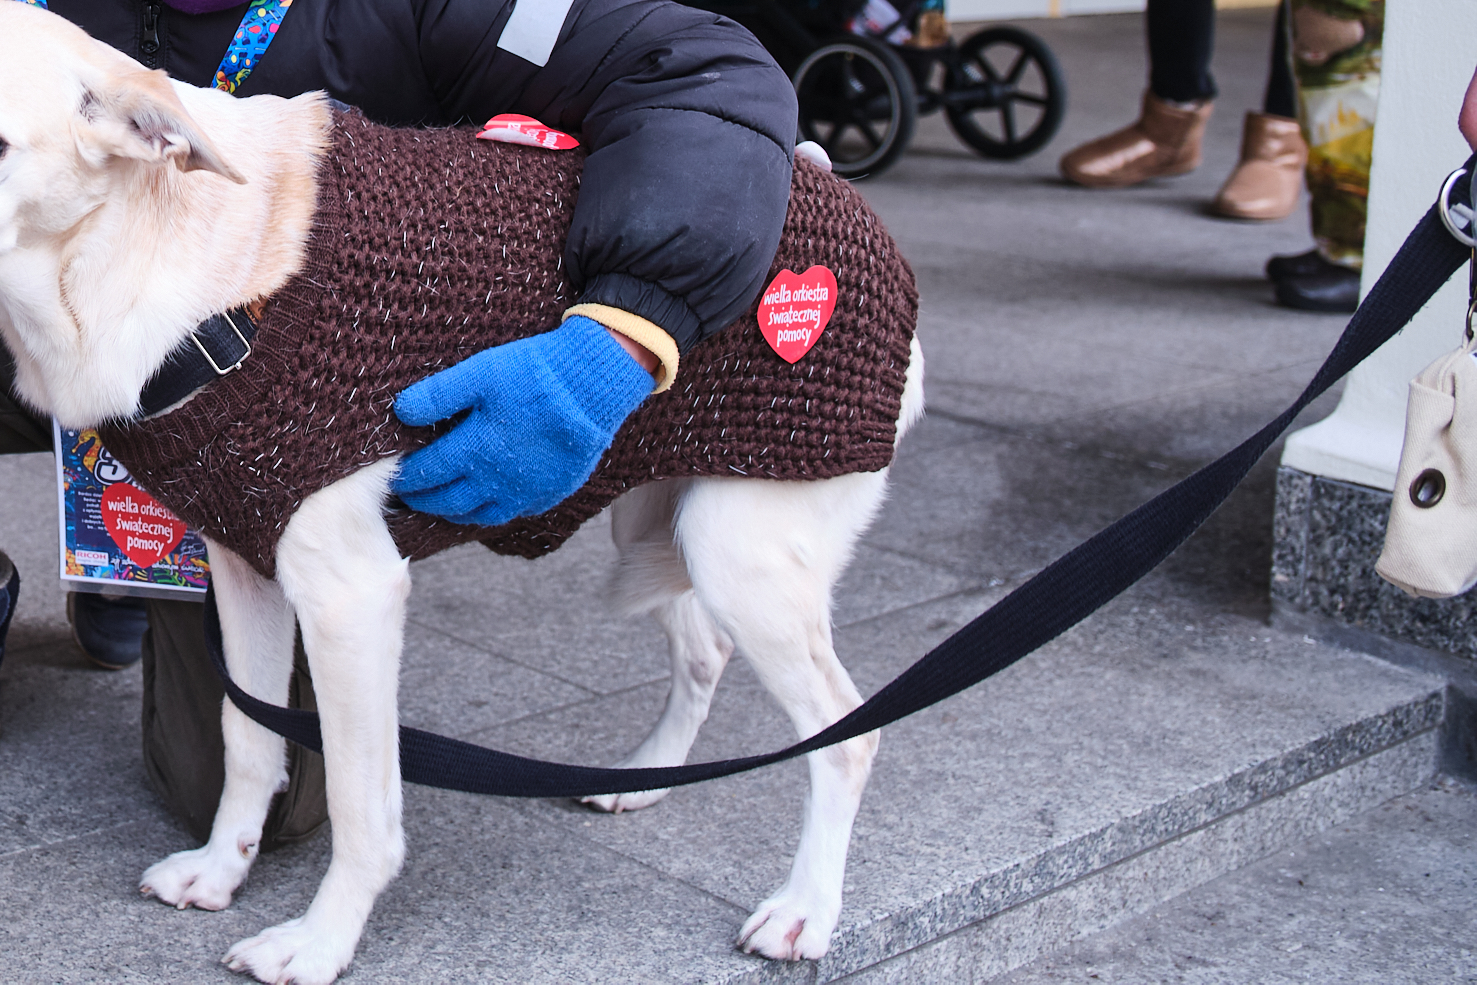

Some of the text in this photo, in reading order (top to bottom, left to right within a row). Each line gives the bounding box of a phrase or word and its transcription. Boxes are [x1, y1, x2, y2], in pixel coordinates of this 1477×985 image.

[764, 282, 828, 305] wielka orkiestra
[768, 304, 821, 329] świątecznej
[777, 328, 812, 348] pomocy
[108, 496, 138, 513] wielka
[116, 514, 173, 544] świątecznej
[76, 551, 107, 559] RICOH
[127, 535, 164, 556] pomocy
